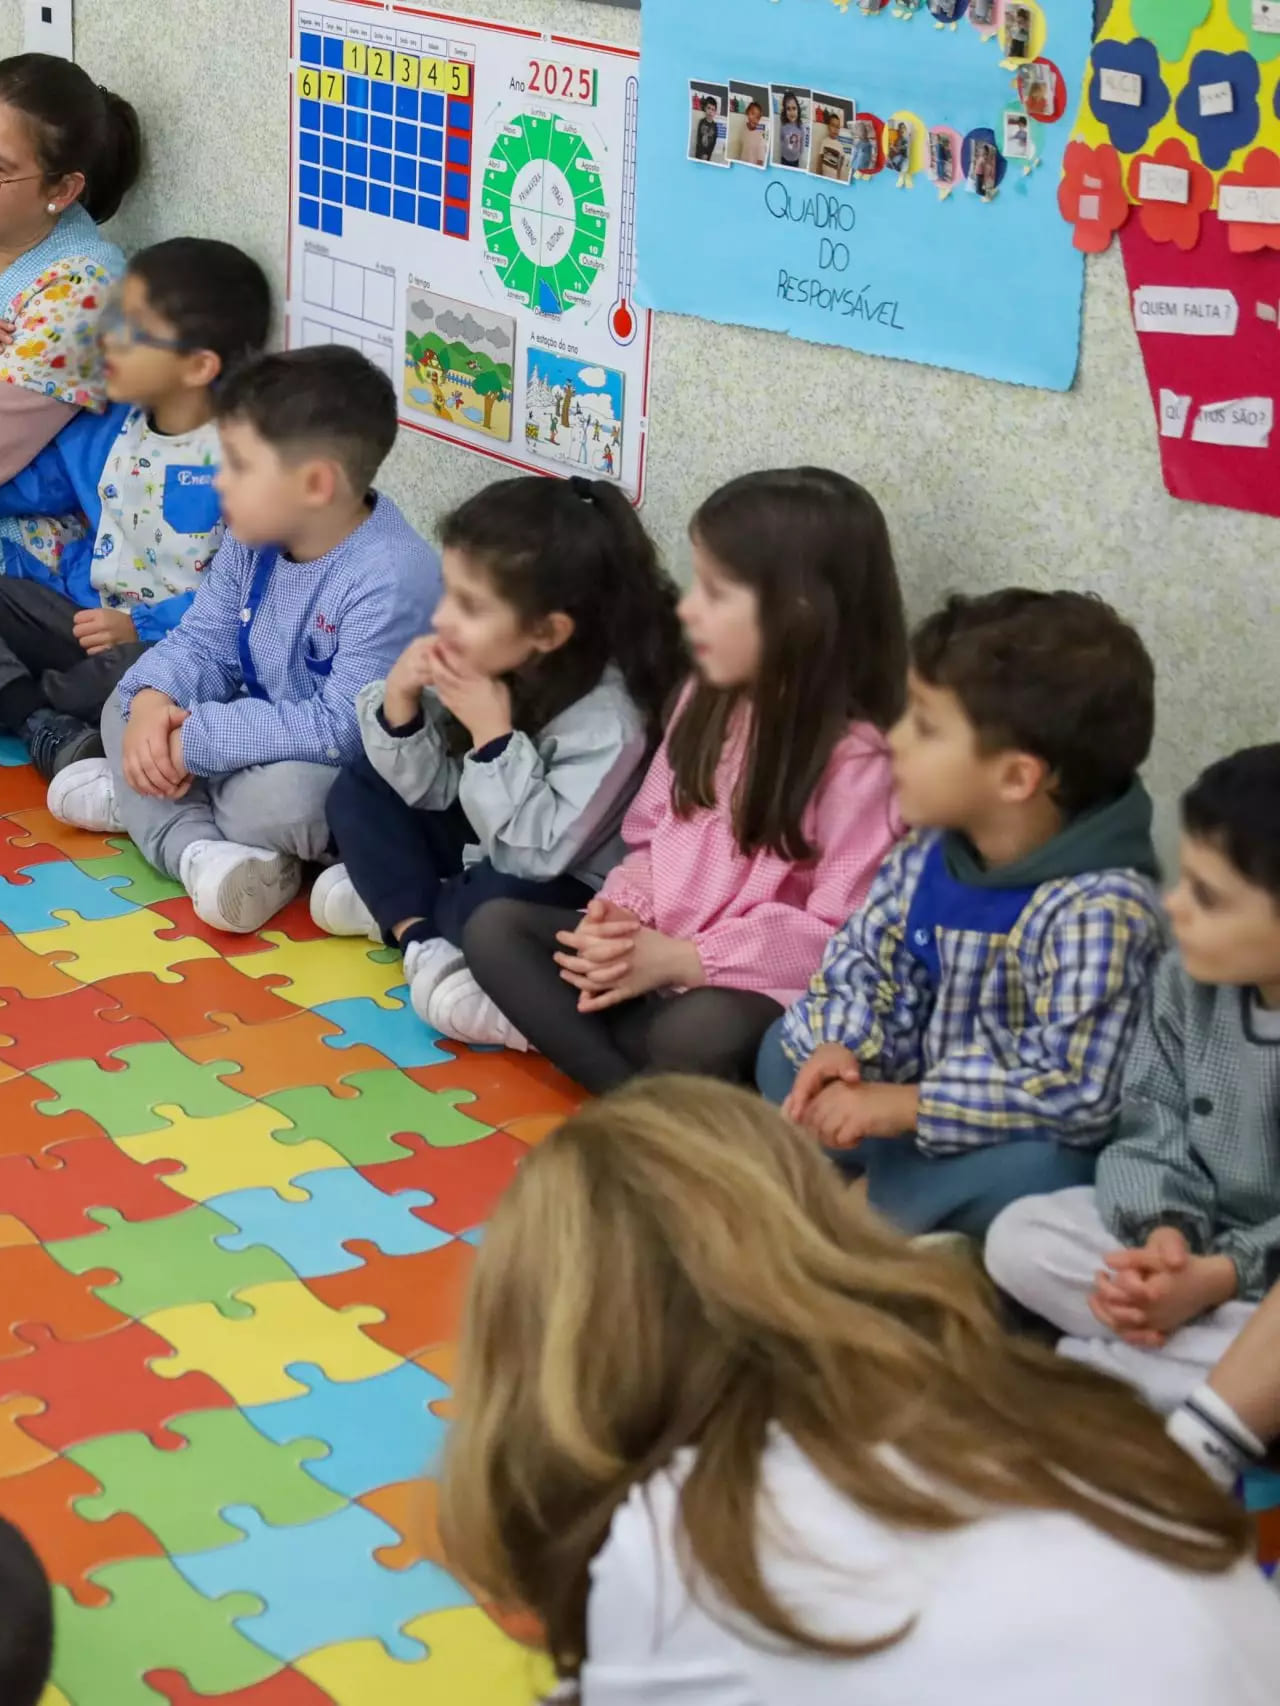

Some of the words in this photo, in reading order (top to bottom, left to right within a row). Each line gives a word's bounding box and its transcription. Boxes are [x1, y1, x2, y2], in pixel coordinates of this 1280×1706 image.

[351, 45, 358, 69] 1
[374, 52, 384, 77] 2
[402, 58, 411, 83] 3
[427, 62, 438, 86] 4
[452, 66, 461, 91] 5
[509, 76, 526, 92] Ano
[528, 60, 591, 100] 2025
[303, 73, 311, 96] 6
[327, 75, 336, 98] 7
[765, 181, 856, 231] QUADRO
[819, 238, 850, 272] DO
[408, 272, 414, 284] O
[777, 269, 904, 330] RESPONSÁVEL
[1140, 301, 1177, 316] QUEM
[1184, 303, 1220, 318] FALTA
[558, 338, 566, 350] do
[567, 344, 579, 355] ano
[1232, 408, 1266, 426] SÃO?
